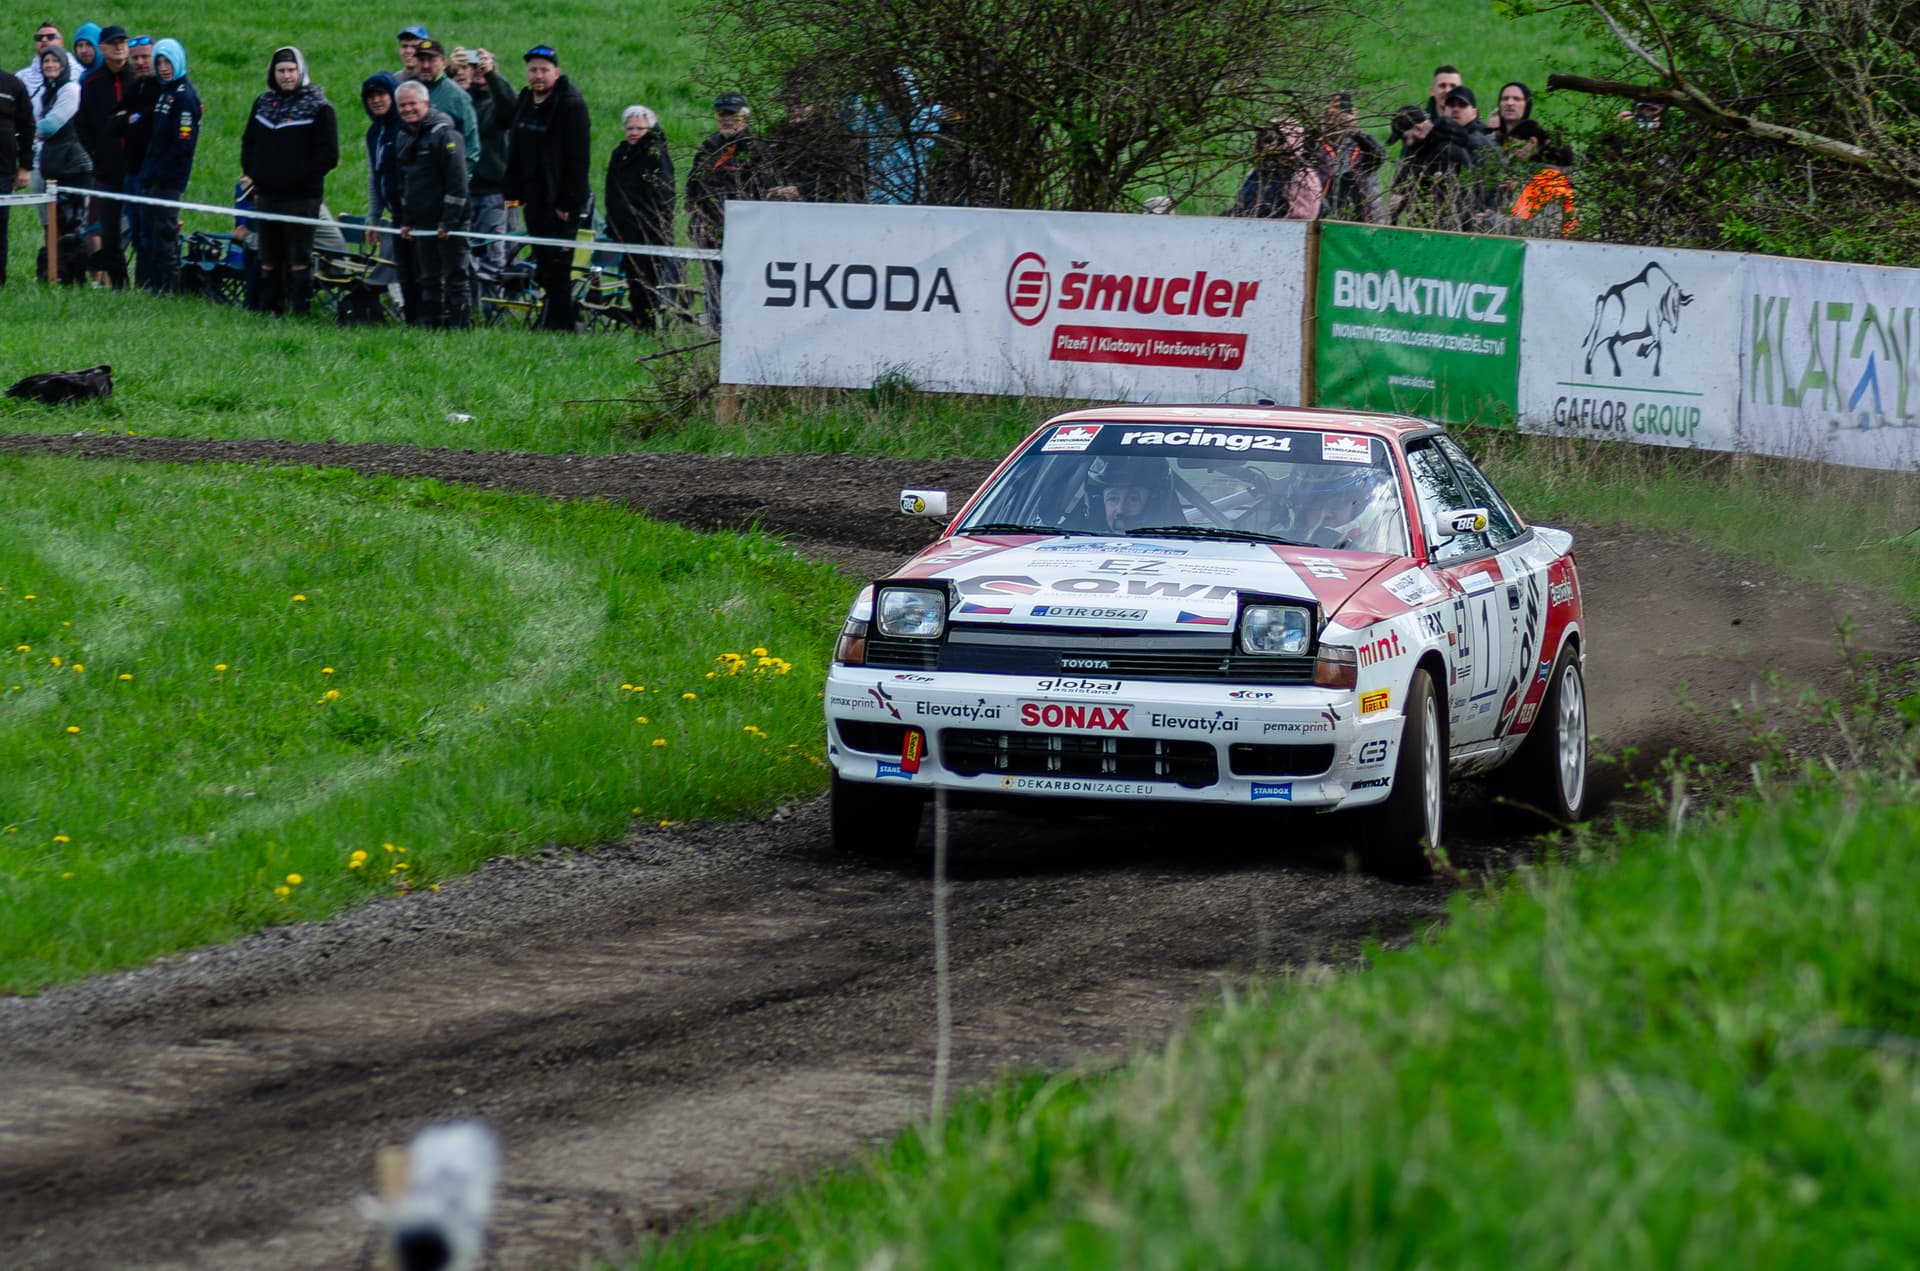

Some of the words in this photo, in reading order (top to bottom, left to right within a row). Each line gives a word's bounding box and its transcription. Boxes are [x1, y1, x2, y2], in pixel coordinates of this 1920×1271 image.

[1098, 336, 1146, 358] Klatovy
[1153, 339, 1217, 361] Horšovský
[1217, 342, 1240, 362] Týn
[1553, 395, 1627, 433] GAFLOR
[1632, 401, 1701, 438] GROUP
[1120, 427, 1292, 452] racing21
[1049, 606, 1088, 617] 01R
[1091, 608, 1141, 619] 0544
[1061, 658, 1110, 669] TOYOTA
[1037, 678, 1122, 691] global
[916, 700, 1001, 721] Elevaty.ai
[1362, 692, 1389, 714] PIRELLI
[1021, 703, 1130, 731] SONAX
[1151, 712, 1239, 734] Elevaty.ai
[1017, 778, 1154, 795] DEKARBONIZACE.EU
